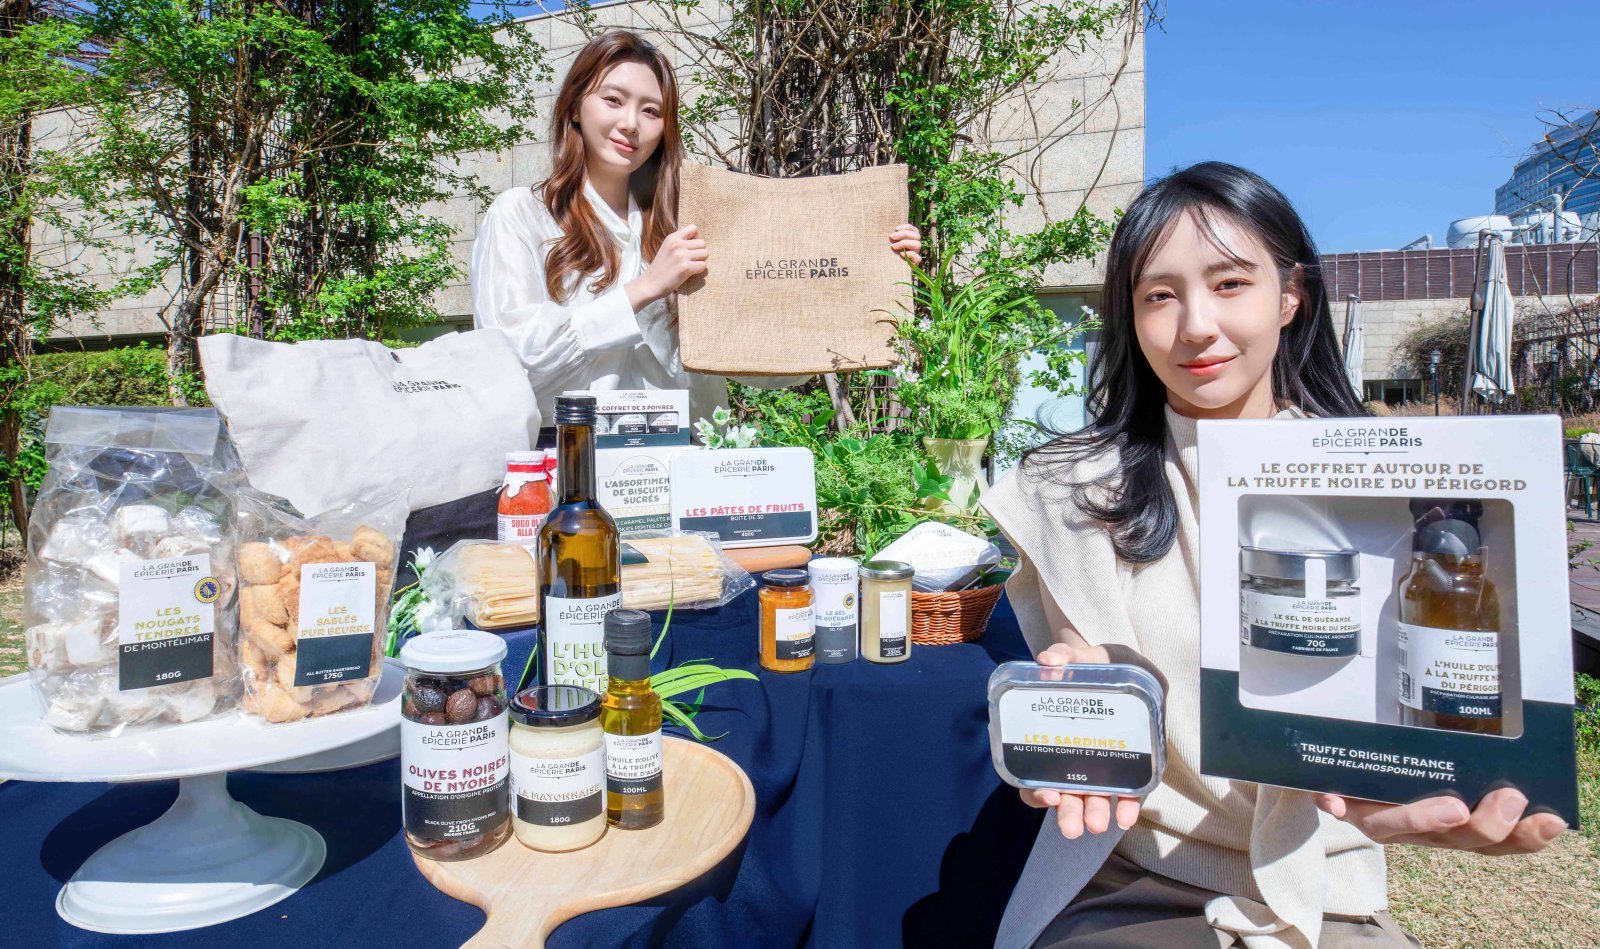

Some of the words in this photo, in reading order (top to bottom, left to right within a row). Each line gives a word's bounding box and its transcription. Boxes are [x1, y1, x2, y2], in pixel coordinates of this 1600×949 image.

[756, 260, 774, 269] LA
[778, 257, 838, 269] GRANDE
[810, 267, 849, 278] PARIS
[1324, 428, 1343, 438] LA
[1346, 428, 1408, 438] GRANDE
[1312, 436, 1377, 448] ÉPICERIE
[1379, 437, 1423, 447] PARIS
[1261, 463, 1281, 473] LE
[1286, 463, 1367, 474] COFFRET
[1373, 463, 1451, 475] AUTOUR
[1458, 464, 1484, 475] DE
[605, 478, 670, 488] L'ASSORTIMEN
[1227, 476, 1249, 487] LA
[1253, 477, 1321, 489] TRUFFE
[1327, 477, 1385, 489] NOIRE
[1391, 478, 1417, 490] DU
[1424, 476, 1527, 491] PÉRIGORD
[628, 486, 668, 495] BISCUITS
[623, 493, 659, 504] SUCRÉS
[686, 507, 707, 517] LES
[710, 506, 745, 516] PÂTES
[748, 505, 762, 513] DE
[766, 503, 805, 512] FRUITS
[512, 519, 530, 528] SUGO
[517, 528, 532, 536] ALLA
[157, 560, 192, 570] GRANDE
[176, 566, 200, 574] PARIS
[328, 606, 347, 615] LES
[585, 598, 620, 612] GRANDE
[156, 607, 182, 617] LES
[560, 611, 606, 620] ÉPICERIE
[135, 614, 201, 630] NOUGATS
[1270, 621, 1300, 630] TRUFFE
[135, 625, 200, 641] TENDRES
[302, 628, 324, 637] PUR
[328, 624, 370, 635] BEURRE
[124, 644, 139, 653] DE
[141, 634, 210, 651] MONTÉLIMAR
[1306, 640, 1326, 648] 70G
[554, 641, 606, 659] L'HU
[554, 659, 606, 677] D'OL
[1434, 660, 1475, 671] L'HUILE
[156, 670, 182, 681] 180G
[323, 672, 343, 680] 175G
[1425, 667, 1432, 676] À
[1435, 670, 1449, 679] LA
[1452, 672, 1489, 682] TRUFFE
[1441, 681, 1456, 689] DU
[1040, 696, 1054, 705] LA
[1057, 697, 1104, 707] GRANDE
[1031, 703, 1080, 714] ÉPICERIE
[1082, 706, 1115, 716] PARIS
[1459, 705, 1492, 715] 100ML
[431, 730, 443, 738] LA
[446, 725, 488, 738] GRANDE
[422, 736, 467, 746] ÉPICERIE
[470, 730, 496, 743] PARIS
[1024, 734, 1050, 744] LES
[1054, 735, 1127, 749] SARDINES
[607, 755, 633, 763] L'HUILE
[635, 753, 659, 763] D'OLIVE
[1025, 745, 1054, 754] CITRON
[1110, 751, 1140, 760] PIMENT
[1301, 742, 1346, 757] TRUFFE
[1349, 749, 1400, 764] ORIGINE
[1403, 756, 1455, 771] FRANCE
[409, 765, 457, 780] OLIVES
[462, 755, 506, 778] NOIRES
[548, 761, 580, 770] GRANDE
[565, 765, 586, 774] PARIS
[629, 762, 655, 770] TRUFFE
[1301, 754, 1335, 765] TUBER
[1336, 759, 1427, 778] MELANOSPORUM
[1428, 771, 1456, 782] VITT.
[1066, 773, 1088, 781] 115G
[424, 781, 441, 792] DE
[447, 773, 496, 793] NYONS
[411, 790, 449, 800] APPELLATION
[450, 791, 481, 800] D'ORIGINE
[518, 787, 528, 797] LA
[531, 783, 600, 801] MAYONNAISE
[449, 822, 476, 833] 210G
